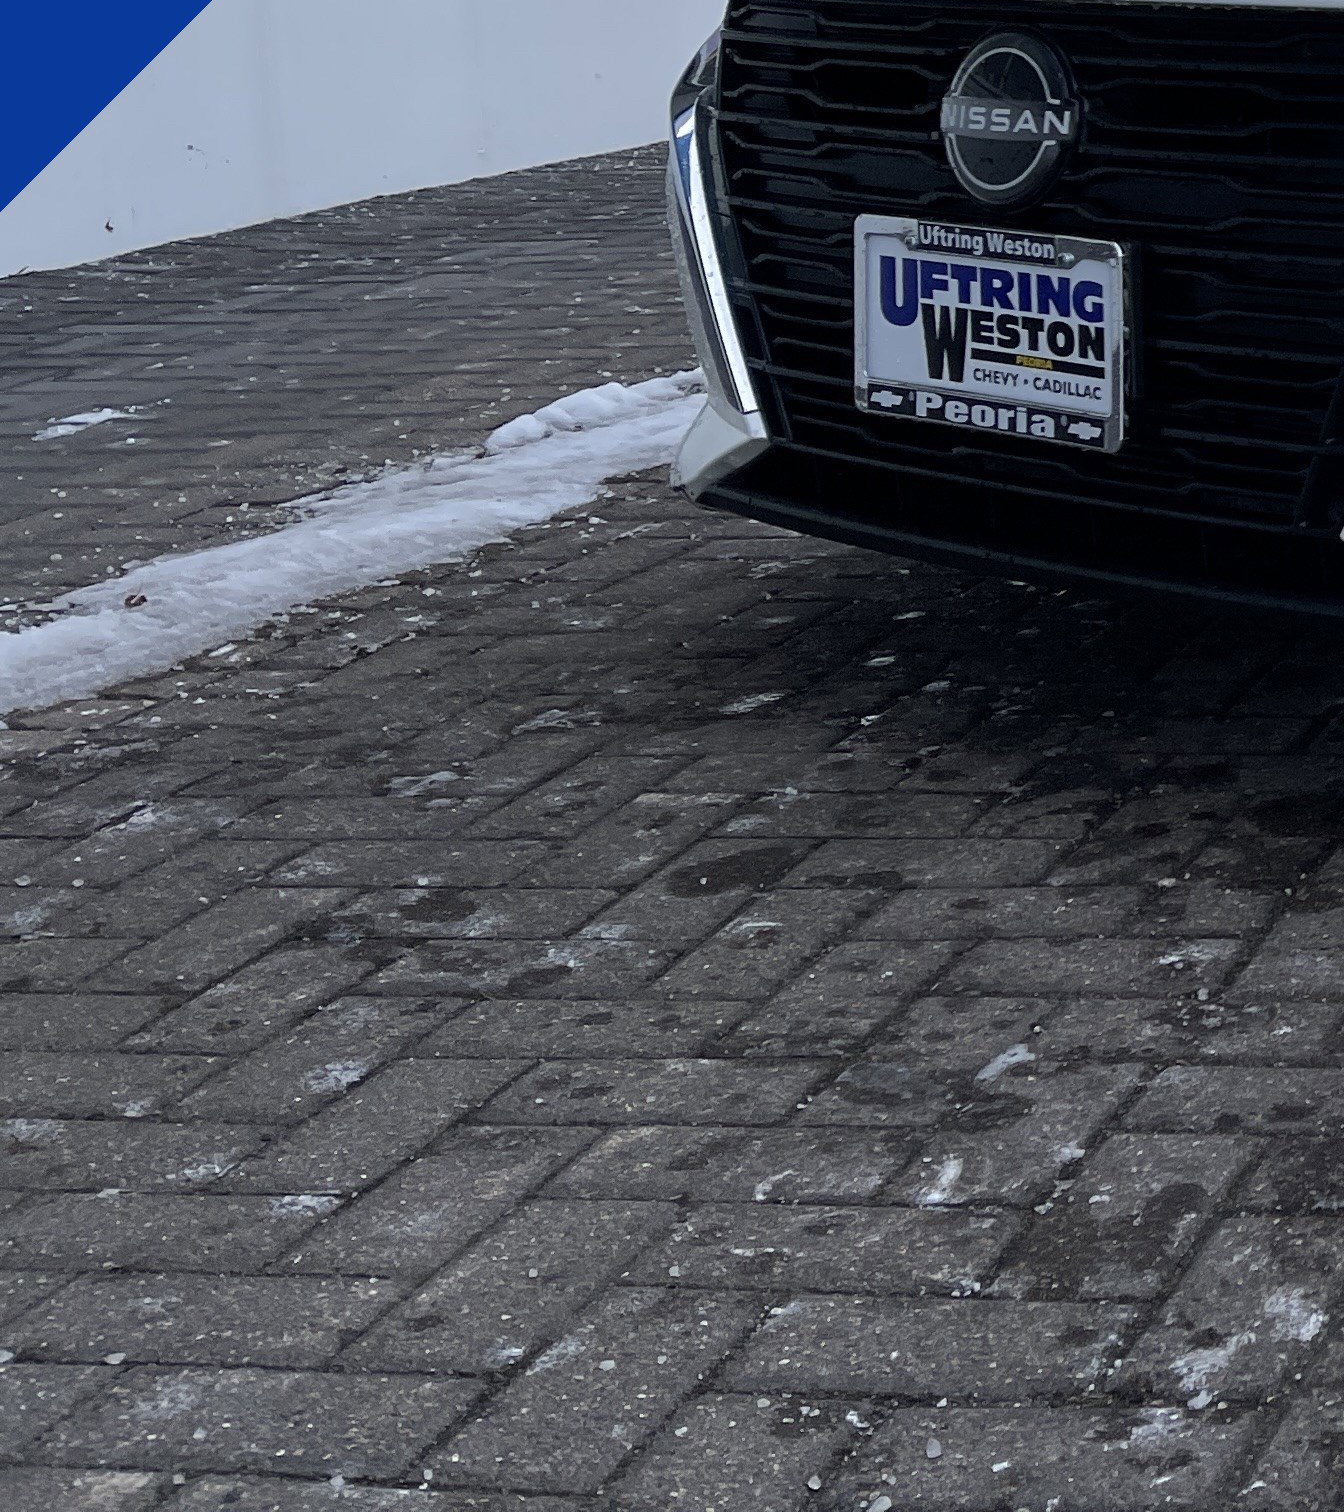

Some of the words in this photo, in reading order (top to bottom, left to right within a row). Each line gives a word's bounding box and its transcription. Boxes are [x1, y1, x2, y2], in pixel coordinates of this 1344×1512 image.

[940, 103, 1072, 135] NISSAN
[919, 225, 983, 255] Uftring
[986, 231, 1056, 260] Weston
[880, 255, 1105, 327] UFTRING
[920, 302, 1106, 384] WESTON
[973, 368, 1019, 388] CHEVY
[1032, 376, 1103, 401] CADILLAC
[915, 391, 1056, 439] Peoria
